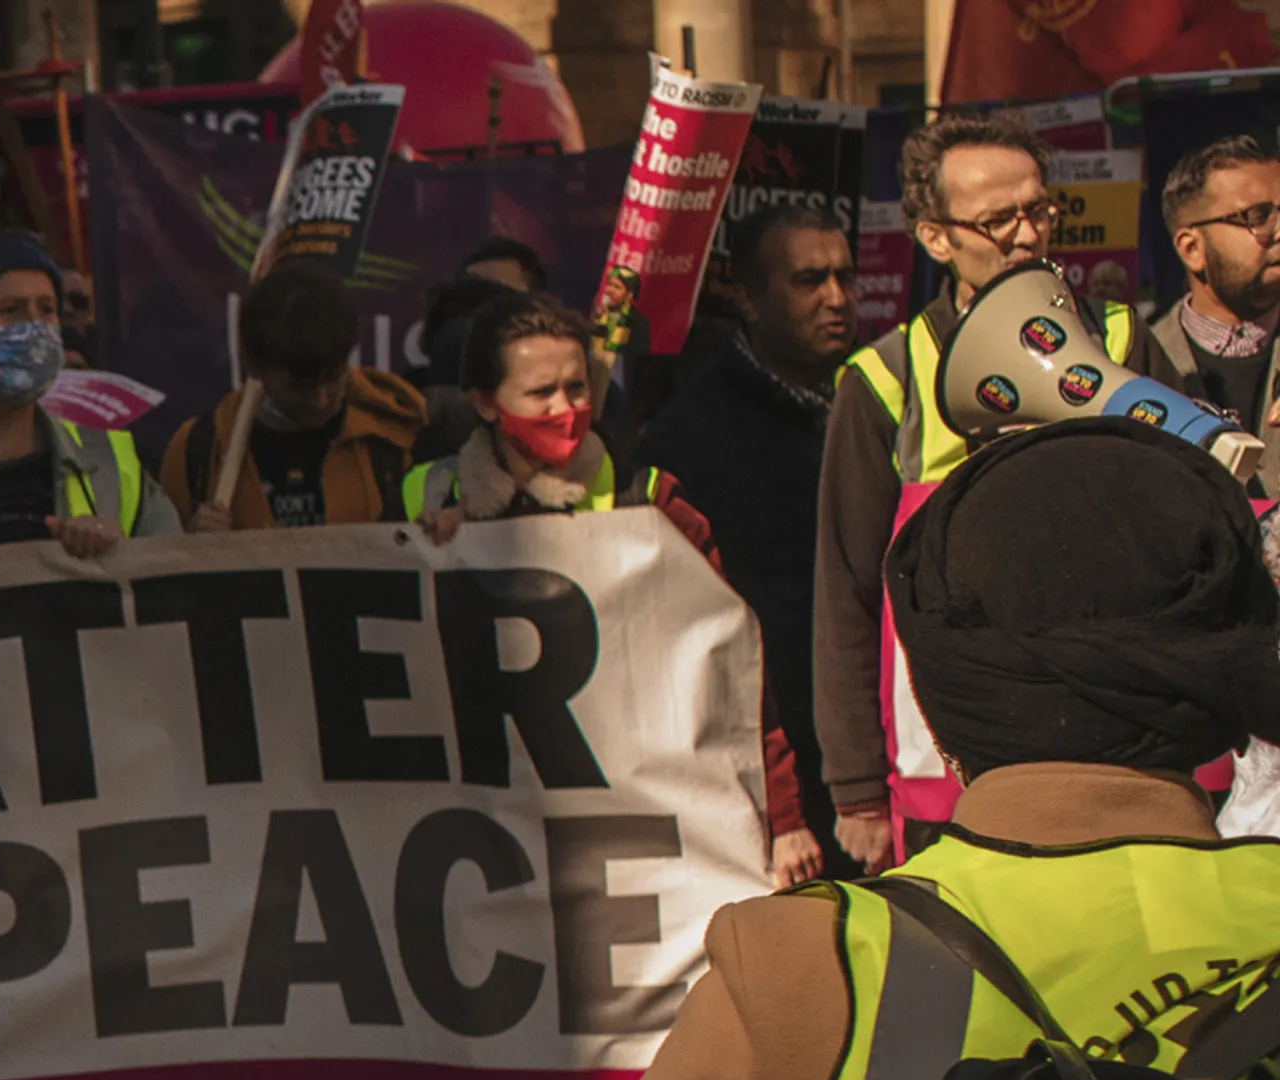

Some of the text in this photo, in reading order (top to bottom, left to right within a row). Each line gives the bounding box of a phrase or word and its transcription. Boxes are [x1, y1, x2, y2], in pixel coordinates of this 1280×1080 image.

[682, 88, 733, 107] RACISM
[648, 143, 730, 179] hostile
[624, 174, 718, 211] onment
[618, 204, 661, 241] the
[1052, 221, 1105, 245] ism
[608, 242, 695, 274] rtations
